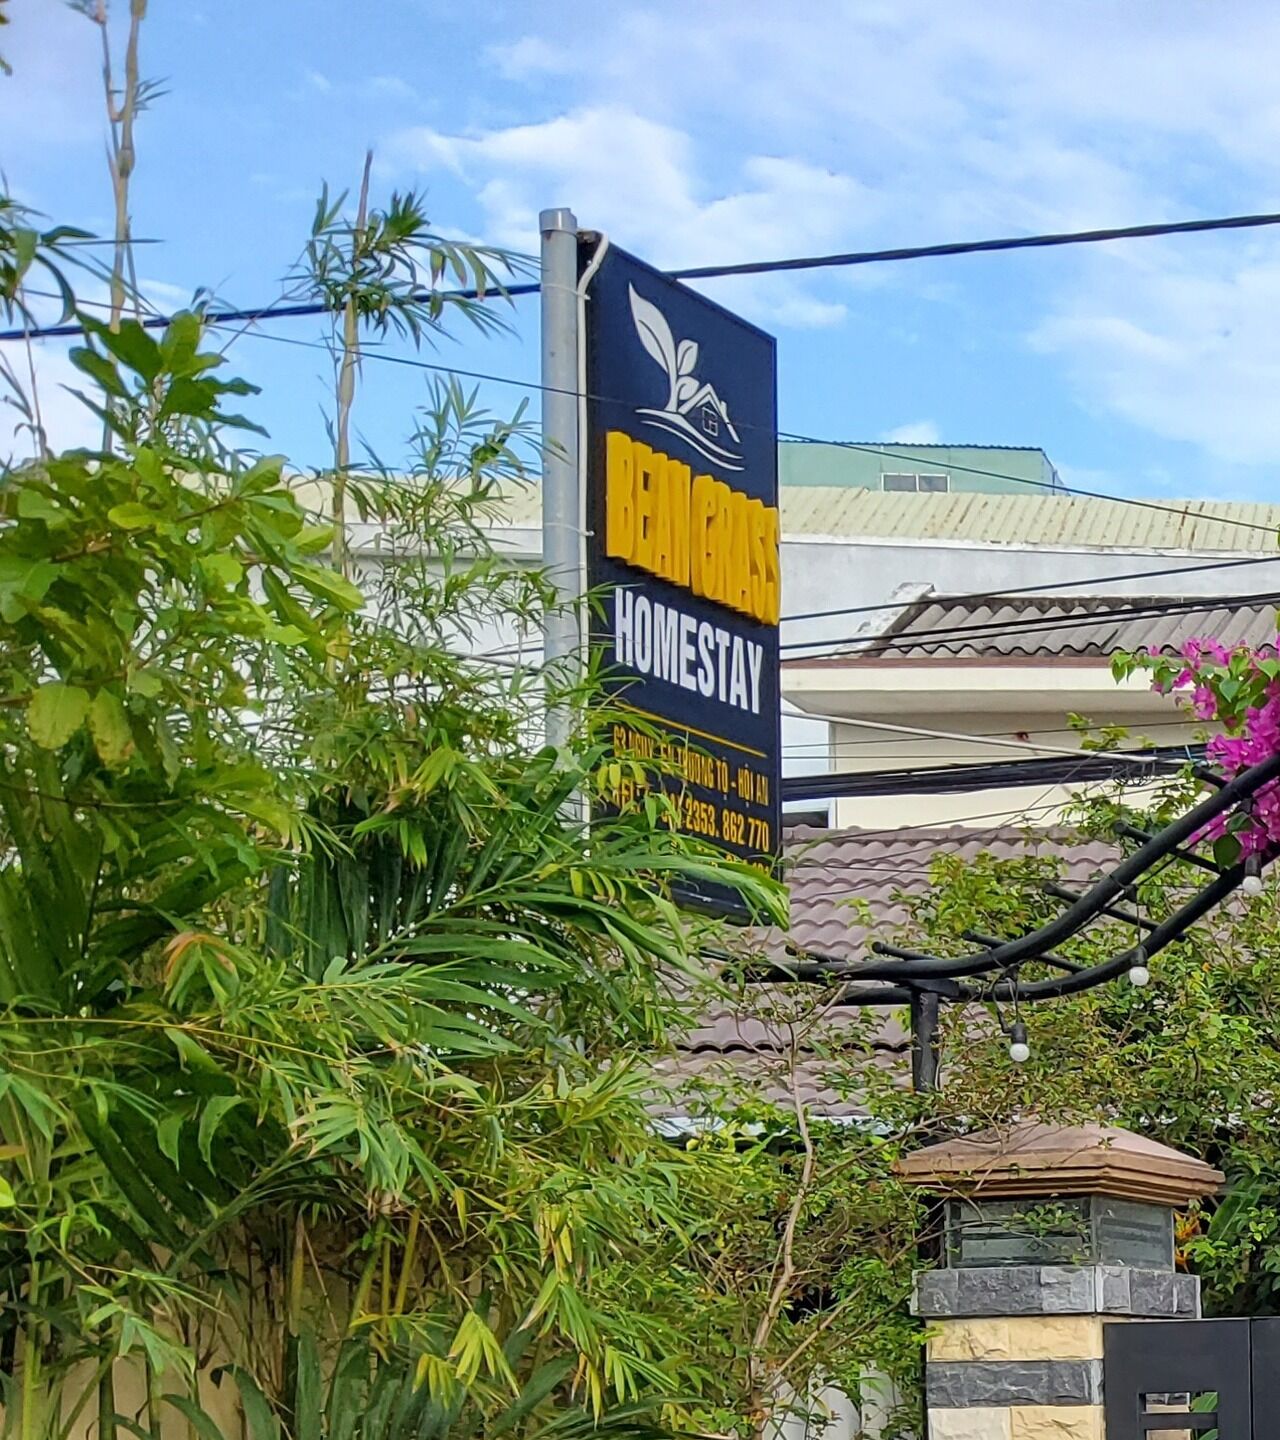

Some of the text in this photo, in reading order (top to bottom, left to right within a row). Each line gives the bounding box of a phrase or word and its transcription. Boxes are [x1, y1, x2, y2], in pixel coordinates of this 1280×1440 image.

[614, 587, 763, 714] HOMESTAY
[757, 773, 769, 807] AN
[722, 808, 745, 845] 862
[748, 817, 769, 852] 770
